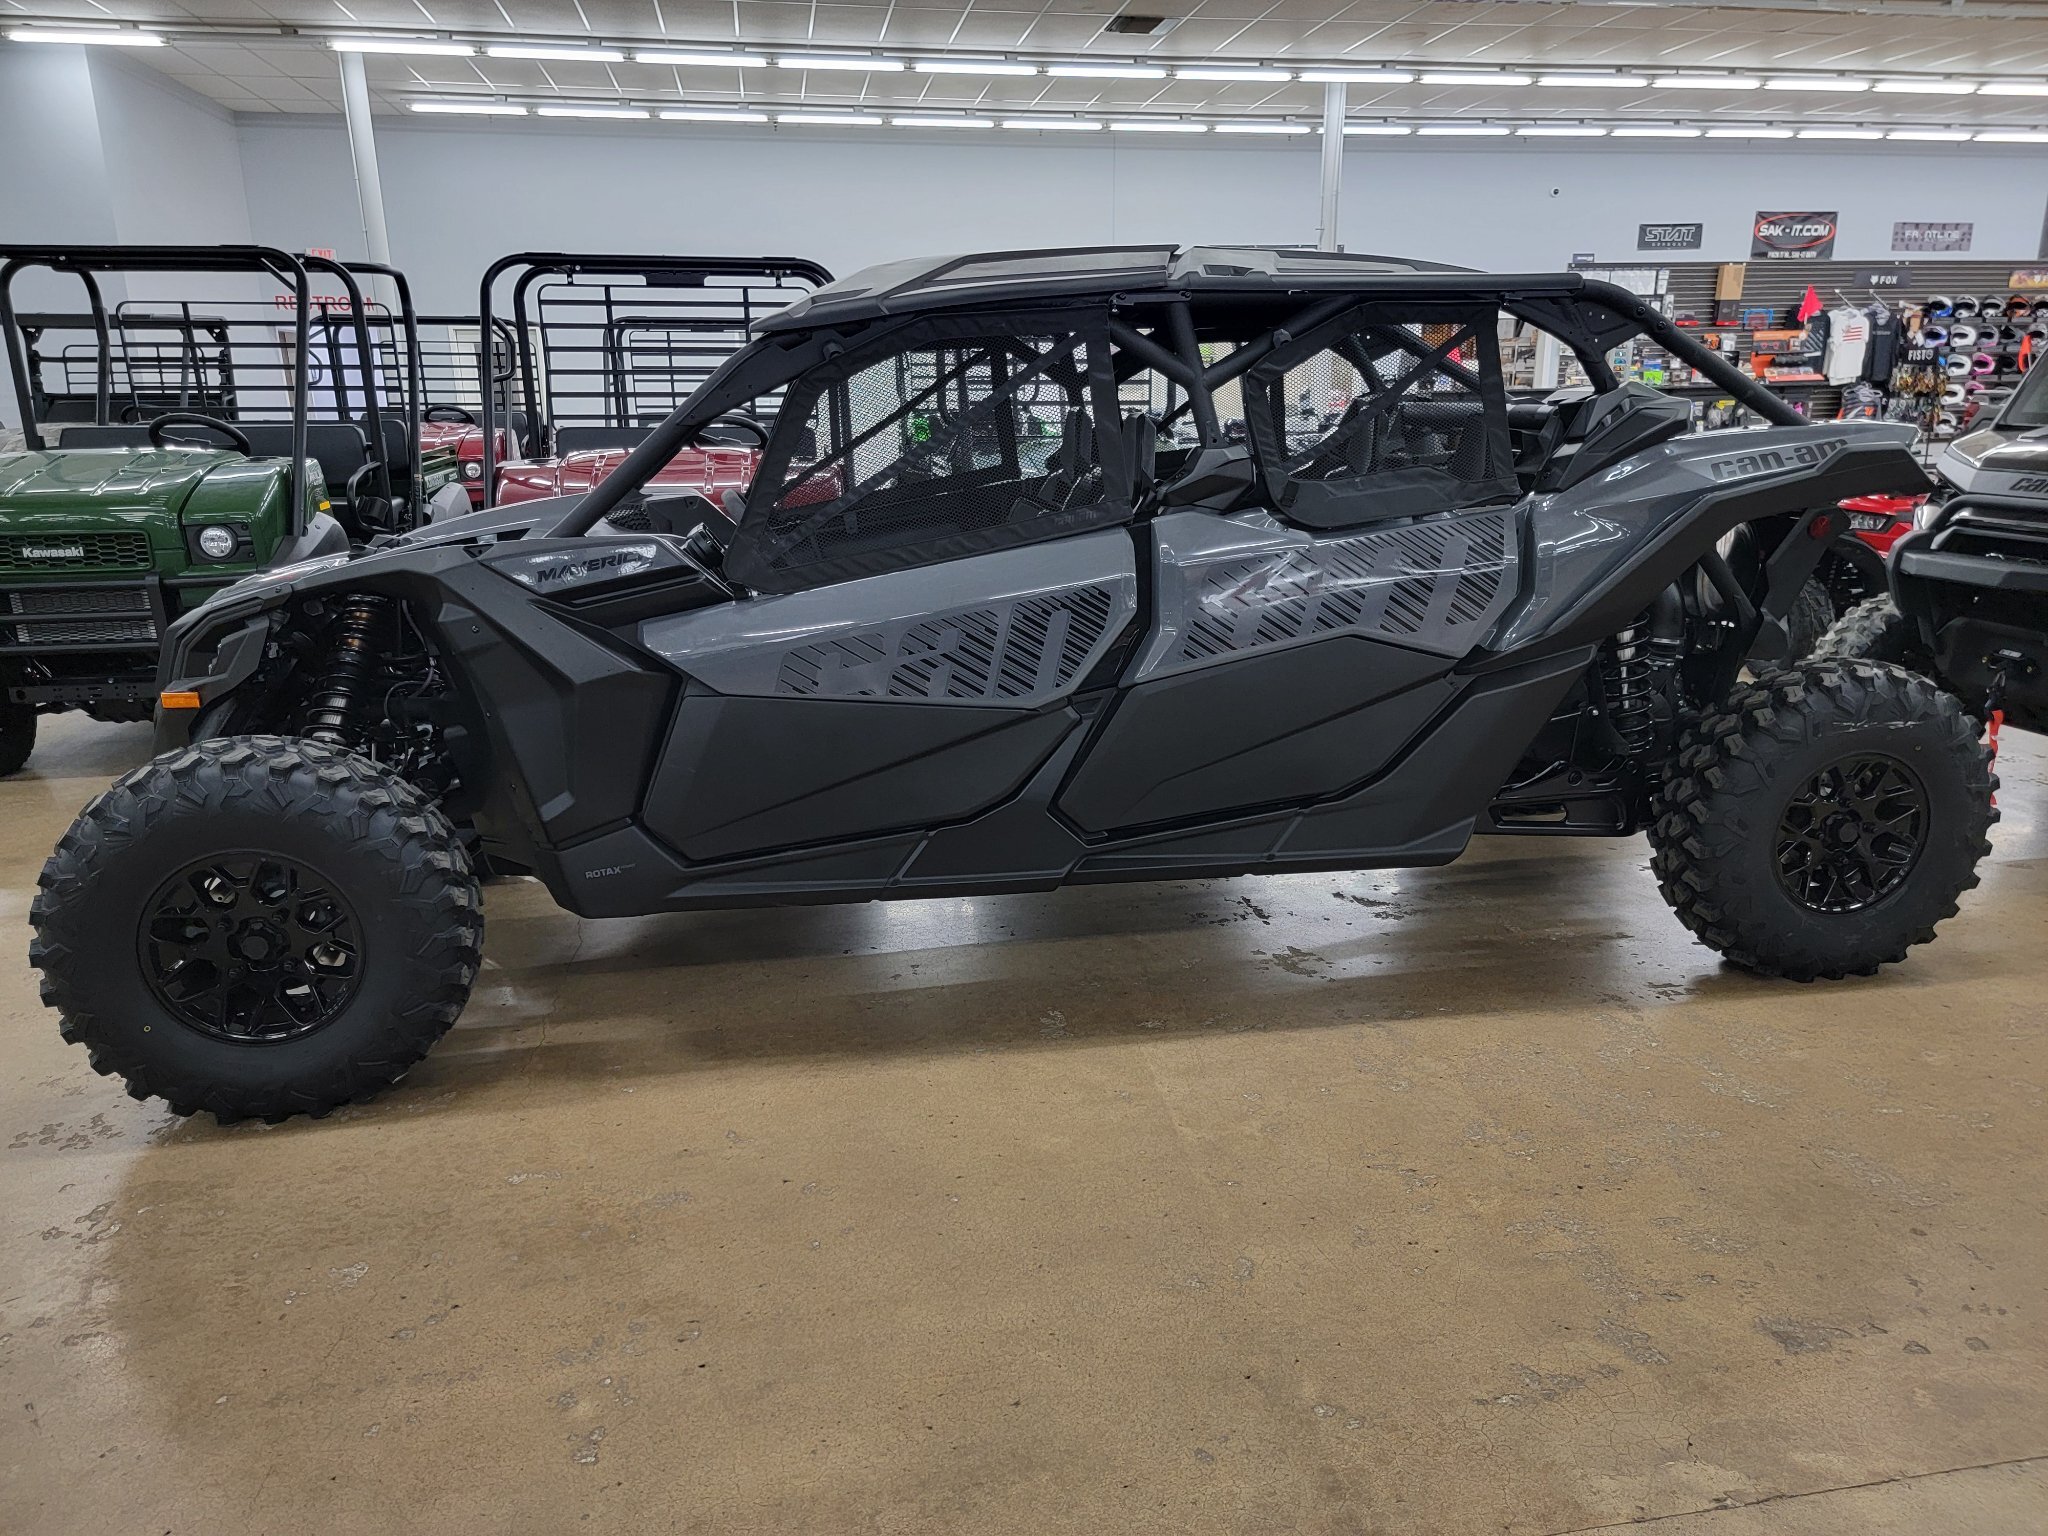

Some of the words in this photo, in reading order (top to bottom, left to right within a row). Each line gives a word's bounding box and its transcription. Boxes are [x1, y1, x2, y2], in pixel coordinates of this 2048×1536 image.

[1645, 226, 1696, 242] STAT
[1879, 275, 1898, 285] FOX
[274, 295, 375, 312] RETROM
[22, 546, 84, 558] Kawasaki
[585, 866, 622, 879] ROTAX
